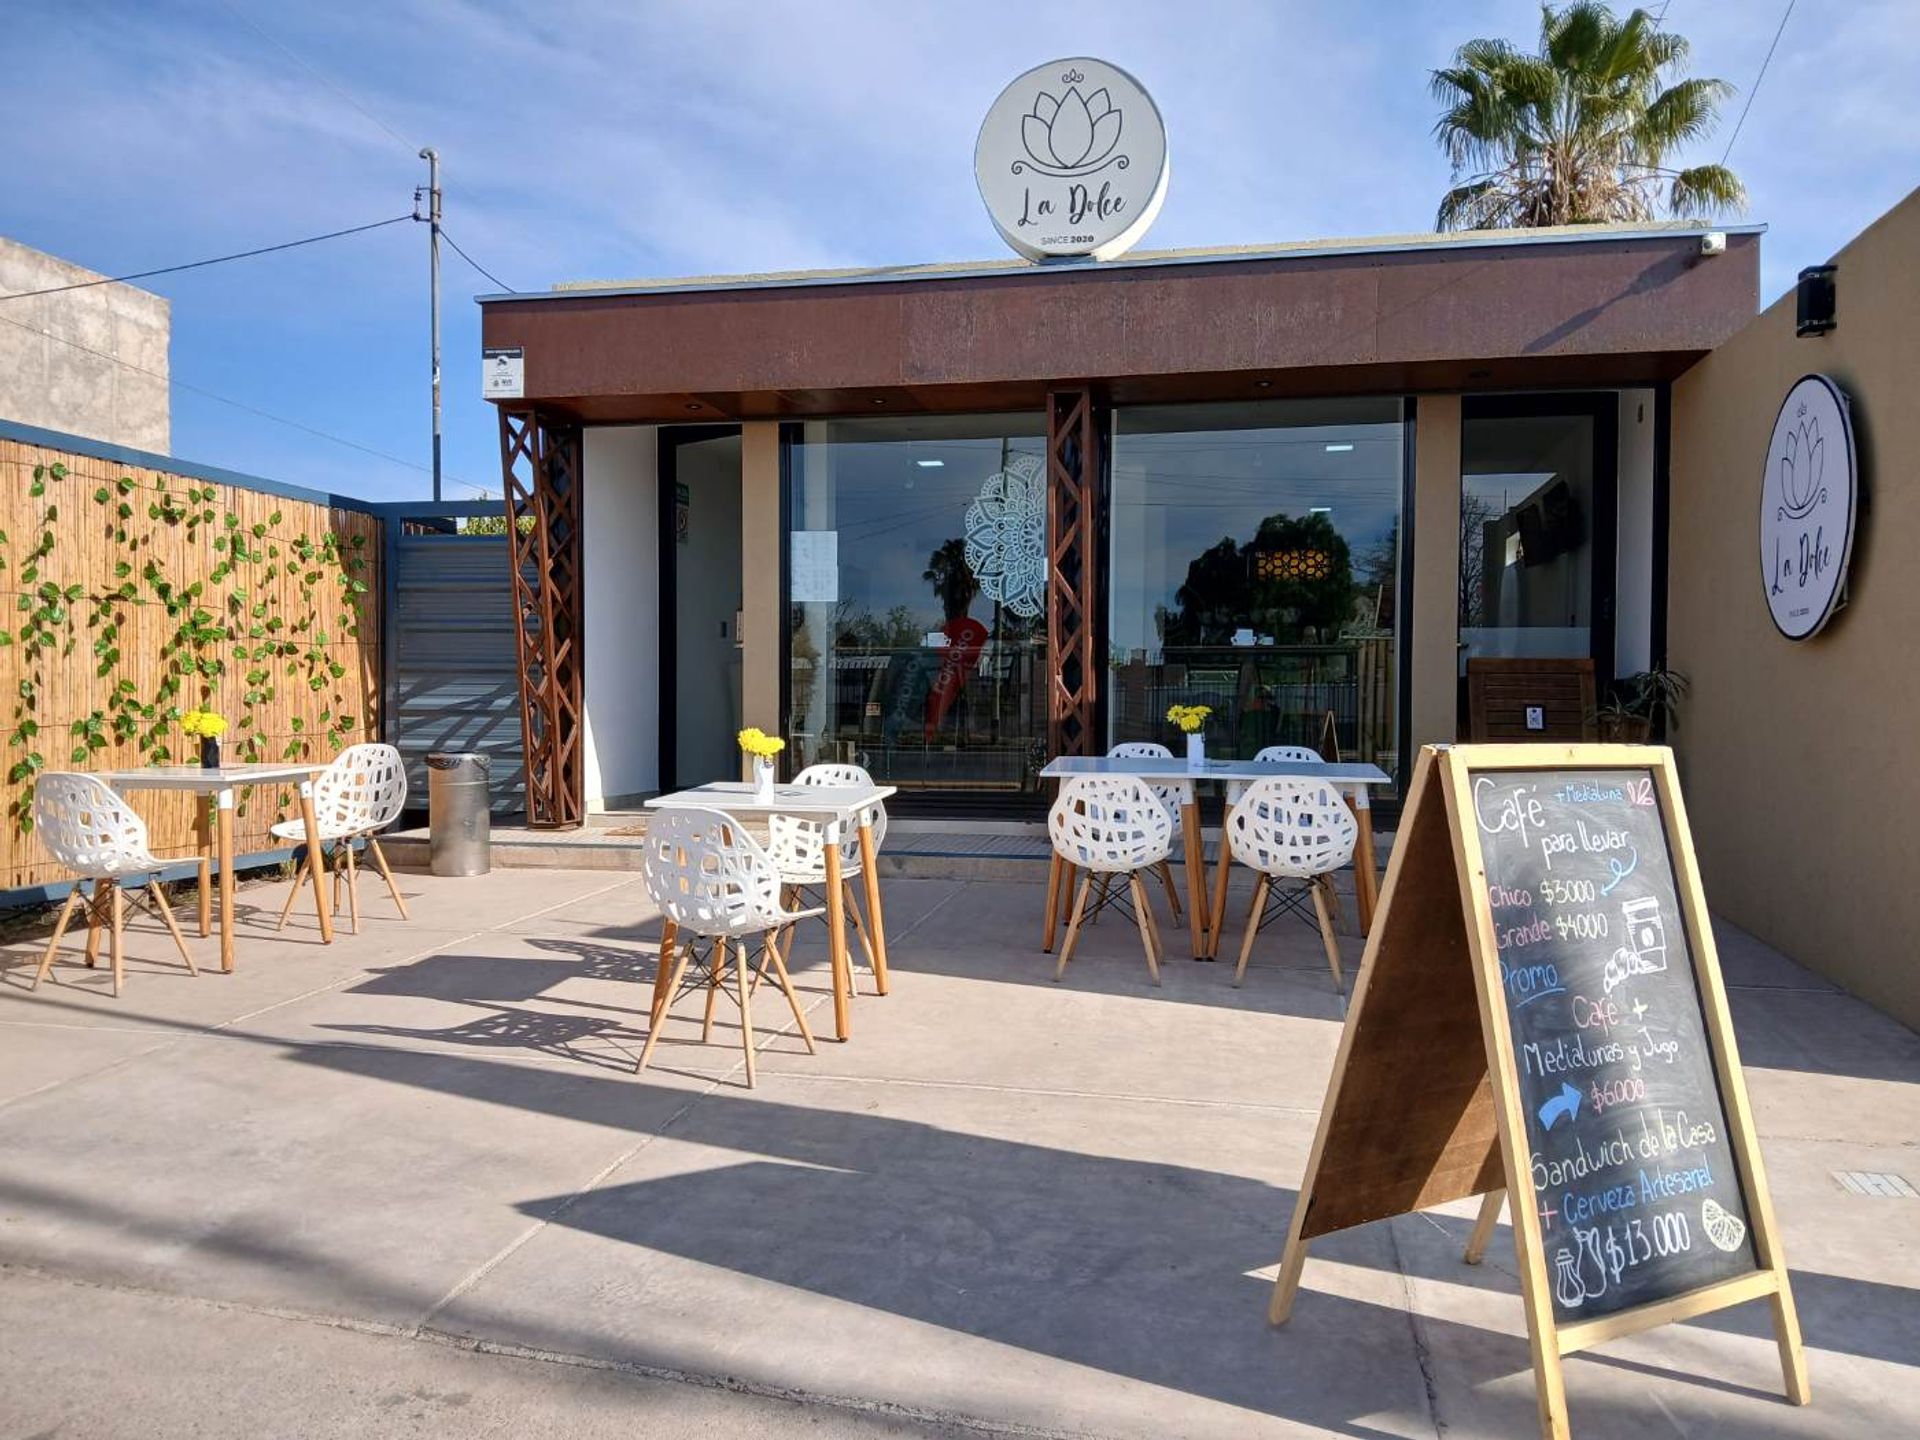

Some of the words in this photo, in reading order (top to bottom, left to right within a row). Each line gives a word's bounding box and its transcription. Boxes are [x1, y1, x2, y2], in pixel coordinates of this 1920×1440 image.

[1018, 187, 1055, 226] La
[1069, 181, 1127, 225] Dolce
[1041, 236, 1069, 246] SINCE
[1070, 235, 1095, 244] 2020
[1772, 537, 1792, 596] La
[1475, 777, 1546, 848] Café
[1541, 832, 1579, 870] para
[1576, 820, 1630, 851] llevar
[1489, 883, 1532, 908] Chico
[1556, 913, 1609, 941] $4000
[1572, 994, 1619, 1037] Café
[1628, 1045, 1642, 1071] y
[1590, 1078, 1645, 1114] $6000
[1530, 1128, 1635, 1191] Sandwich
[1639, 1110, 1659, 1159] de
[1677, 1110, 1717, 1149] Casa
[1563, 1184, 1636, 1225] Cerveza
